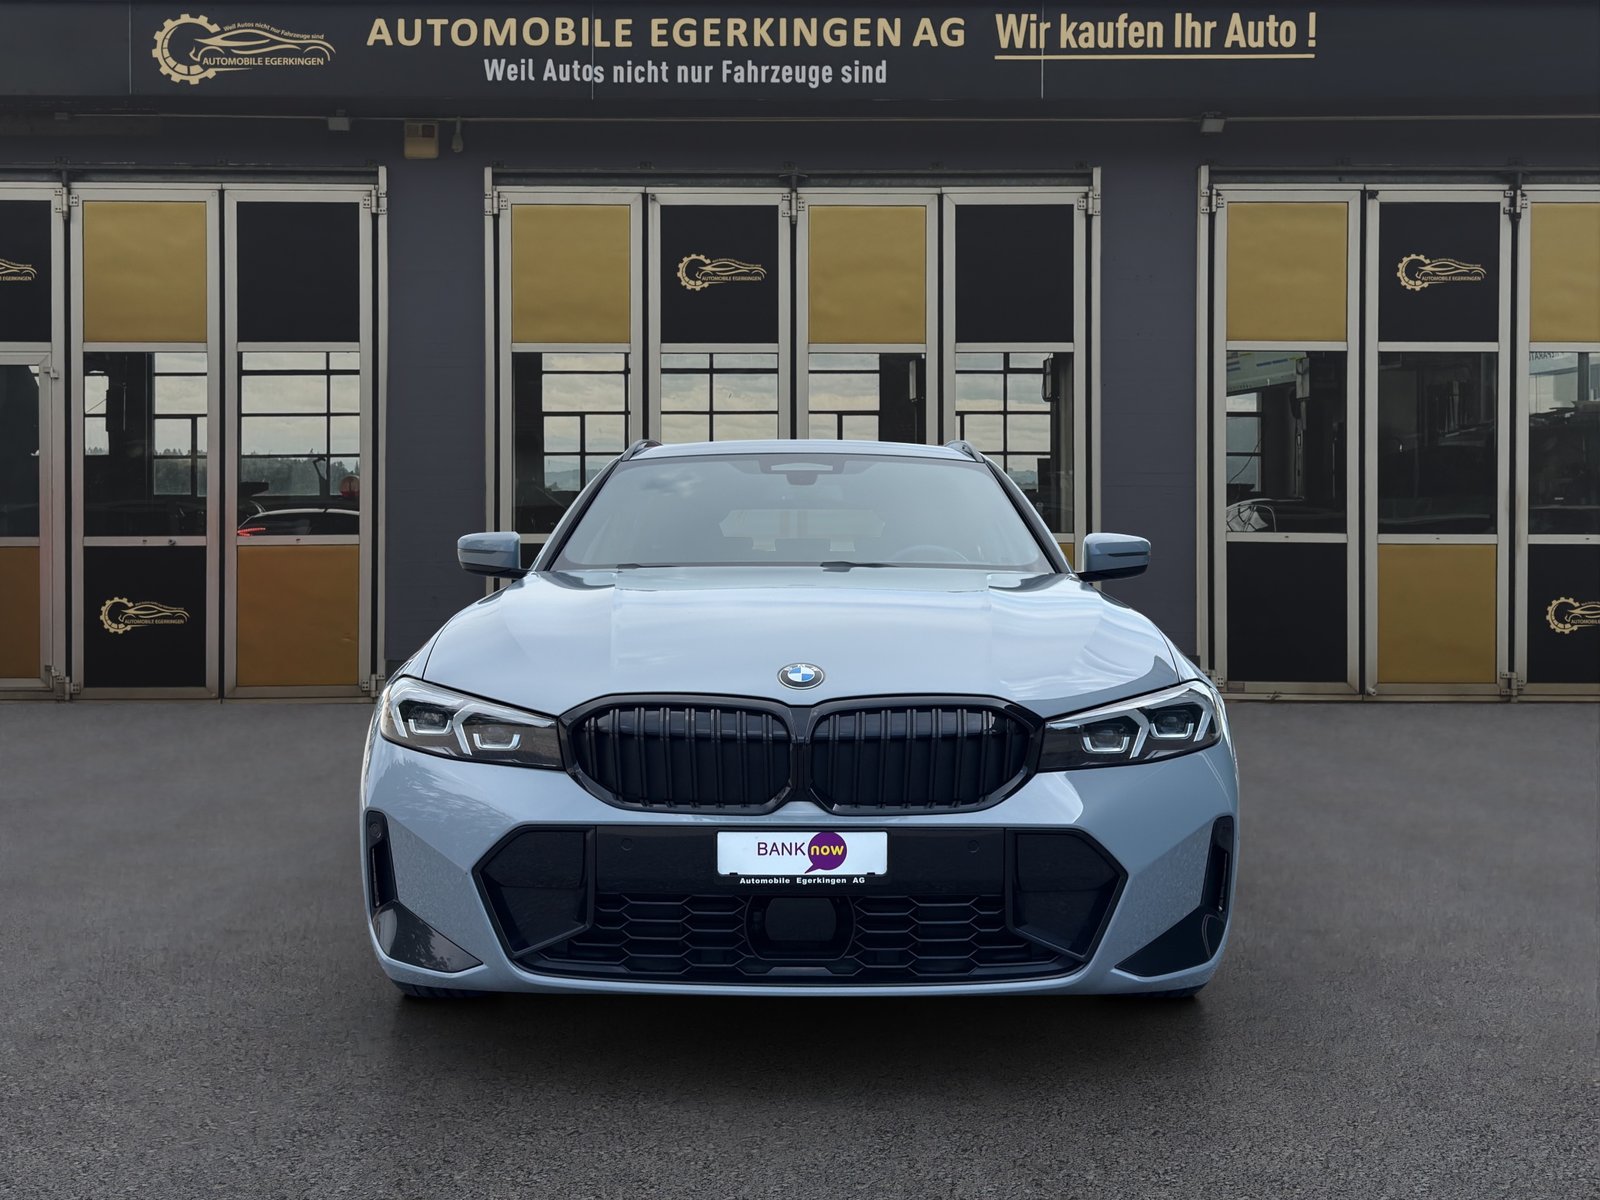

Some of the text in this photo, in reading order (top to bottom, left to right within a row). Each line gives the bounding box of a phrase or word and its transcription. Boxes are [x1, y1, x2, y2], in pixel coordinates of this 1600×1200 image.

[223, 23, 237, 32] Weil
[255, 22, 271, 31] nicht
[280, 29, 311, 40] Fahrzeuge
[366, 16, 965, 48] AUTOMOBILE EGERKINGEN AG
[995, 13, 1051, 49] Wir
[1059, 12, 1164, 48] kaufen
[1174, 12, 1217, 48] Ihr
[1223, 12, 1297, 48] Auto
[202, 57, 324, 66] AUTOMOBILE EGERKINGEN
[484, 58, 888, 89] Weil Autos nicht nur Fahrzeuge sind
[757, 842, 844, 856] BANK now
[796, 877, 847, 886] Egerkingen
